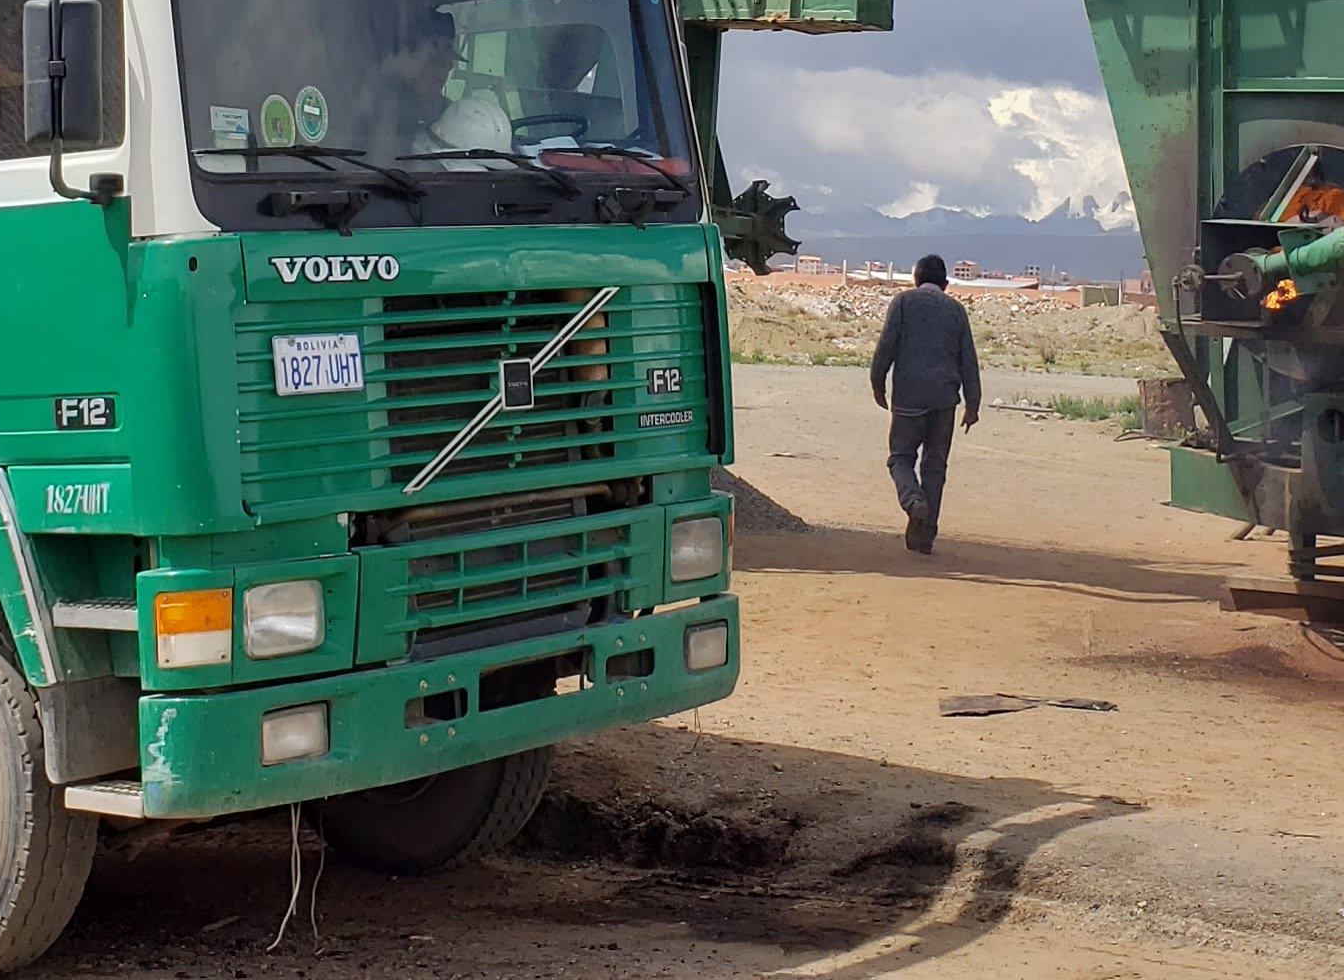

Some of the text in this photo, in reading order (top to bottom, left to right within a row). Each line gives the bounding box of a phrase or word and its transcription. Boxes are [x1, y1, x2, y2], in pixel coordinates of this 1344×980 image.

[270, 255, 400, 283] VOLVO
[296, 339, 339, 351] BOLIVIA
[281, 353, 359, 388] 1827 UHT
[653, 368, 681, 393] F12
[61, 397, 107, 426] F12
[640, 410, 694, 427] INTERCOOLER
